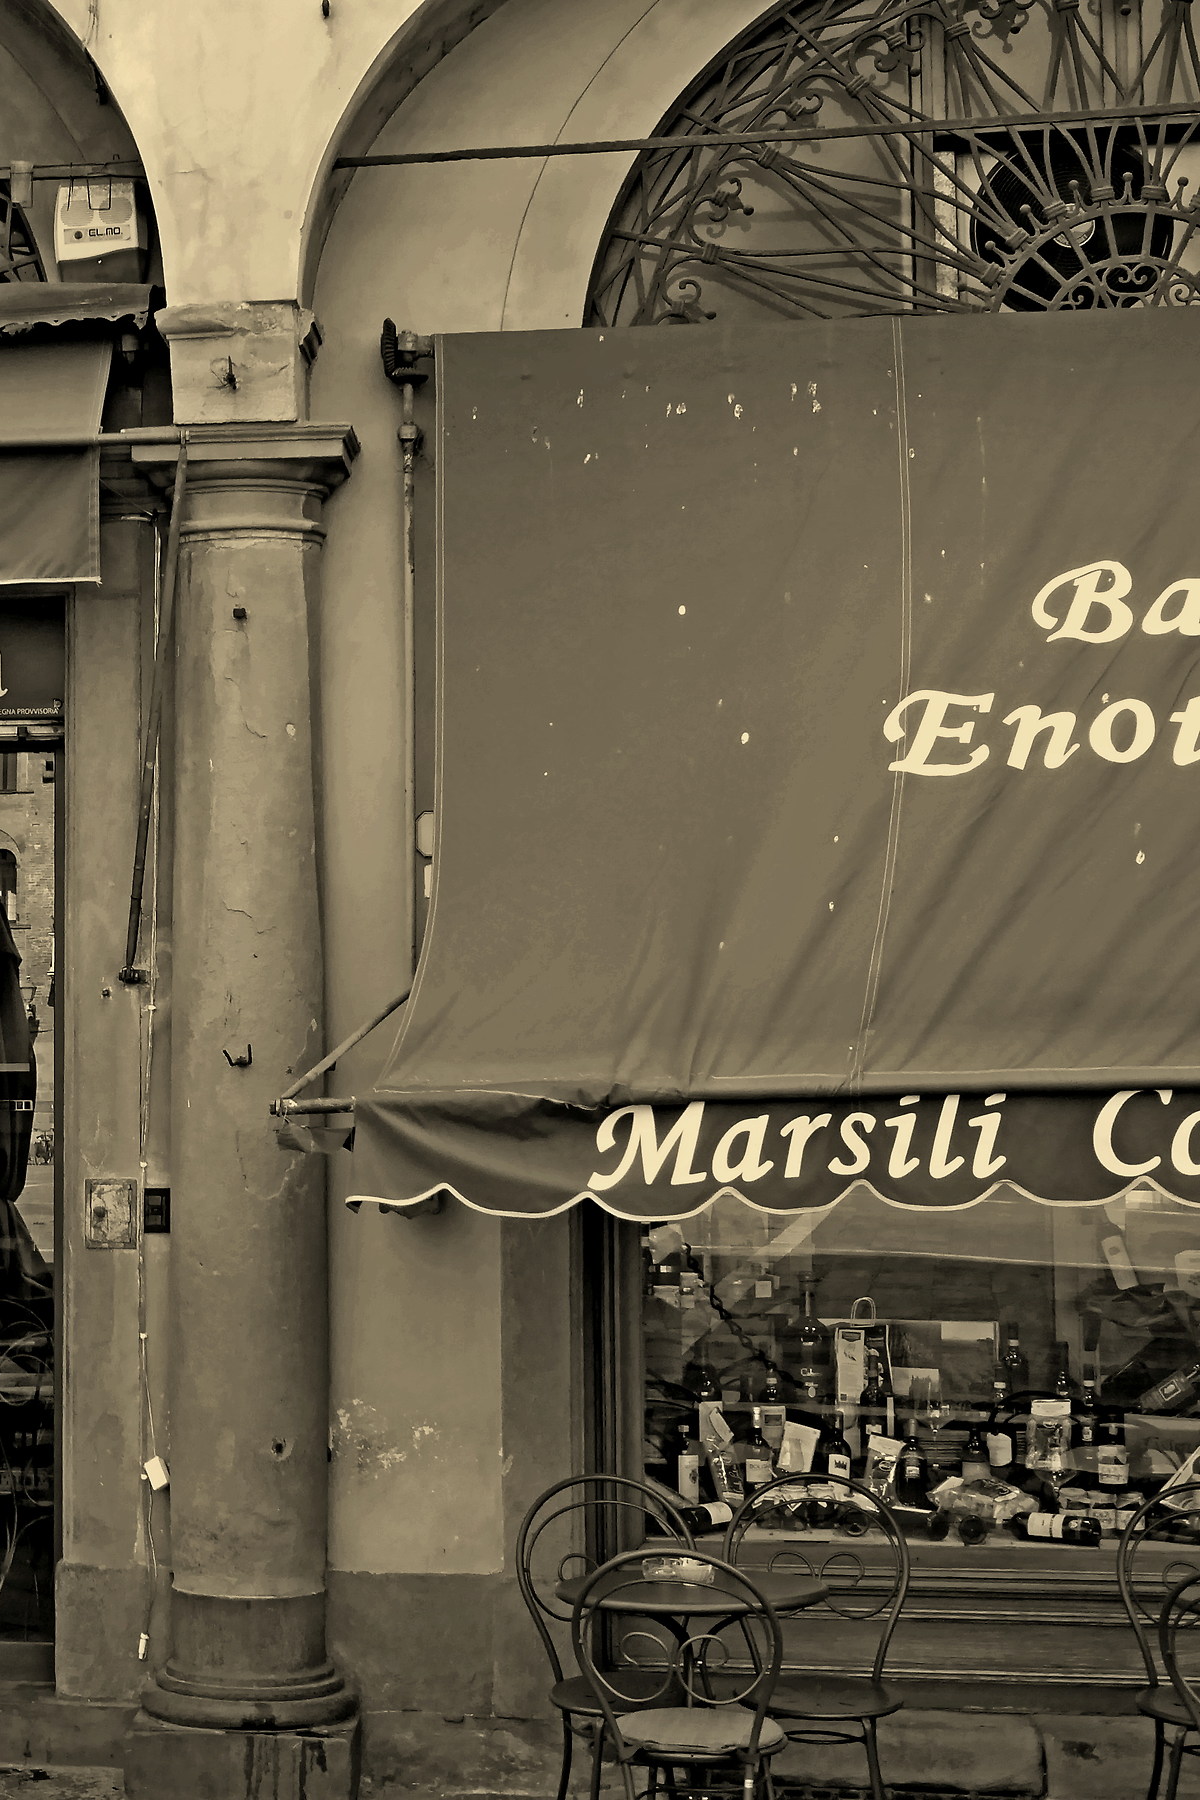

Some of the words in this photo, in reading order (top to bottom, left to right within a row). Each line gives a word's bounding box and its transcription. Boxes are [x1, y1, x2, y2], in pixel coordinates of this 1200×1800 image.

[1032, 560, 1200, 644] Ba
[16, 707, 59, 715] PROVVISORIA
[587, 1093, 1007, 1191] Marsili
